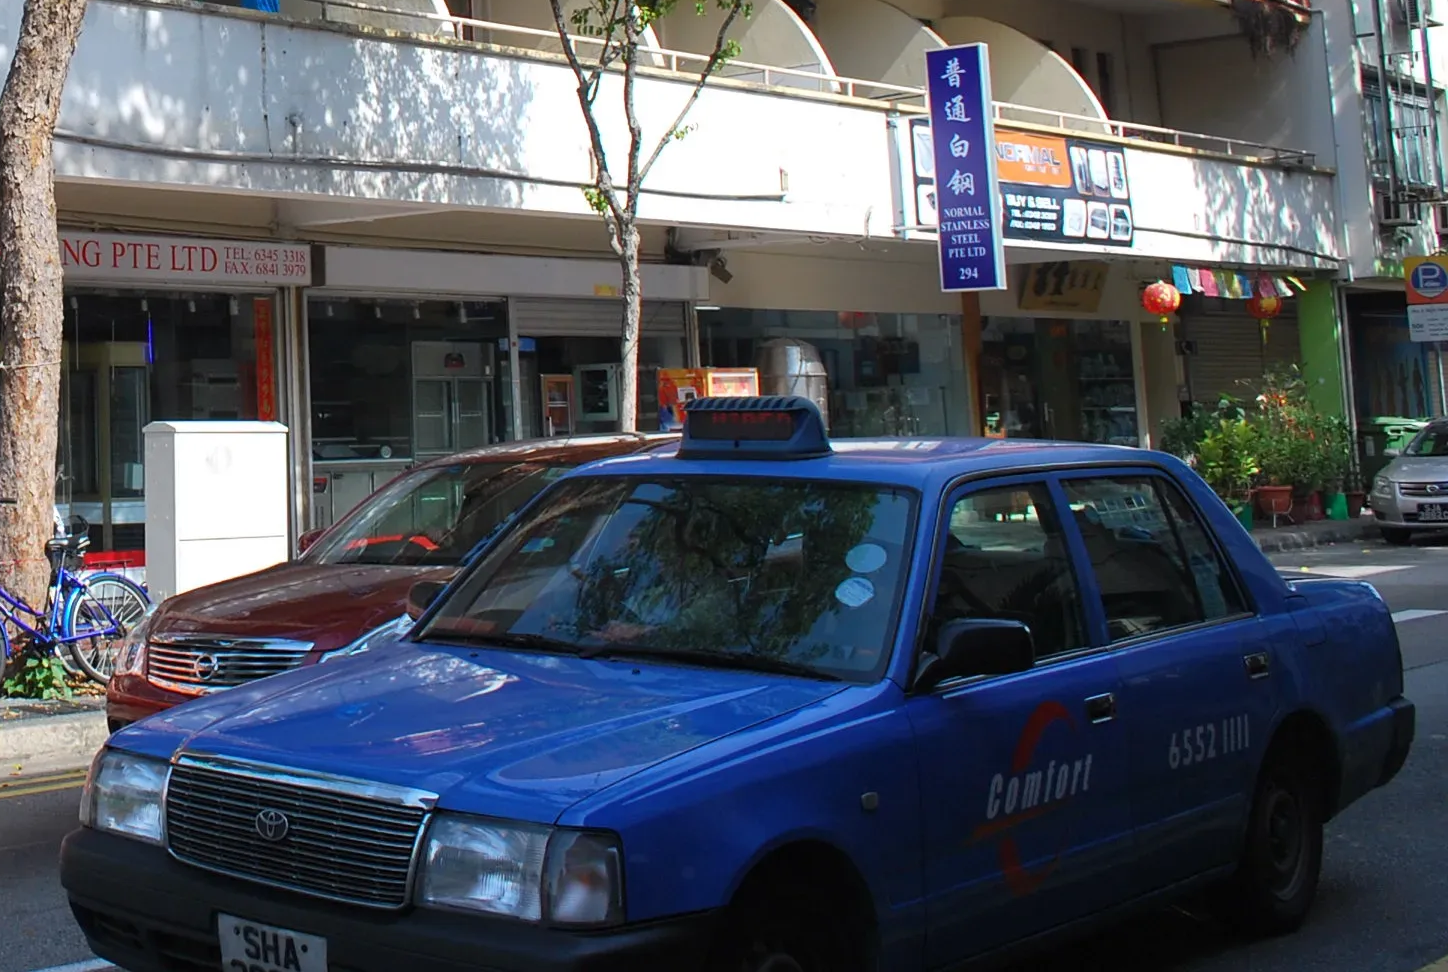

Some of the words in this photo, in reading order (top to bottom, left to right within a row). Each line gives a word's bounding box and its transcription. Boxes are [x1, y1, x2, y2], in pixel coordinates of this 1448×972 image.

[941, 58, 975, 197] 普通白鋼
[944, 206, 984, 218] NORMAL
[941, 219, 990, 232] STAINLESS
[951, 233, 981, 245] STEEL
[111, 241, 161, 270] PTE
[171, 244, 218, 272] LTD
[224, 246, 252, 260] TEL:
[254, 248, 279, 262] 6345
[282, 249, 306, 263] 3318
[948, 247, 965, 259] PTE
[968, 246, 986, 258] LTD
[224, 261, 253, 275] FAX:
[255, 262, 280, 276] 6841
[282, 263, 306, 277] 3979
[959, 267, 978, 280] 294
[1168, 726, 1216, 770] 6552
[986, 754, 1093, 819] Comfort
[242, 924, 303, 972] SHA
